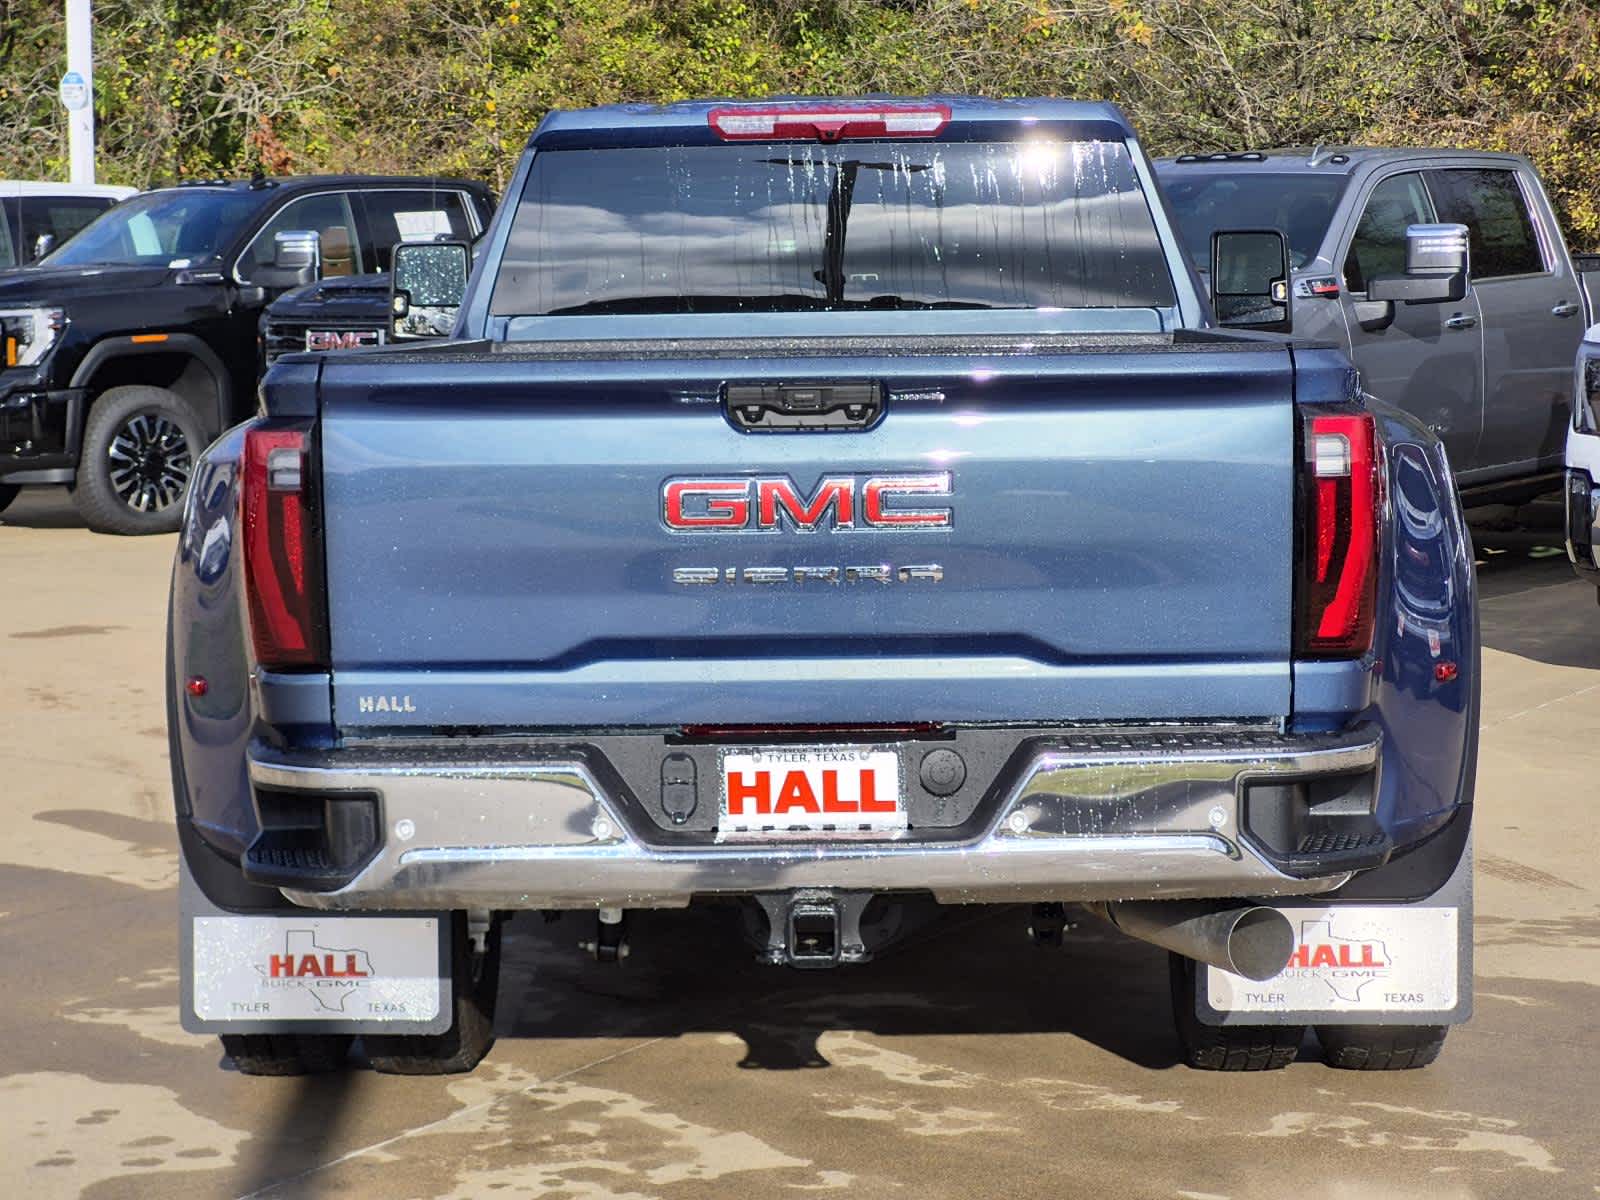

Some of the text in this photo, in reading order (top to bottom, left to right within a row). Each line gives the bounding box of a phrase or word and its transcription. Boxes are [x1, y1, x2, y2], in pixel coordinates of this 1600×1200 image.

[309, 331, 377, 350] GMC
[660, 473, 953, 534] GMC
[672, 564, 944, 585] SIERRA
[359, 695, 417, 713] HALL
[768, 752, 856, 763] TYLER, TEXAS
[727, 769, 896, 814] HALL
[1286, 944, 1384, 968] HALL
[270, 954, 368, 978] HALL
[1332, 970, 1389, 978] GMC
[1246, 992, 1285, 1003] TYLER
[1384, 992, 1425, 1003] TEXAS
[231, 1002, 271, 1013] TYLER
[368, 1002, 407, 1013] TEXAS
